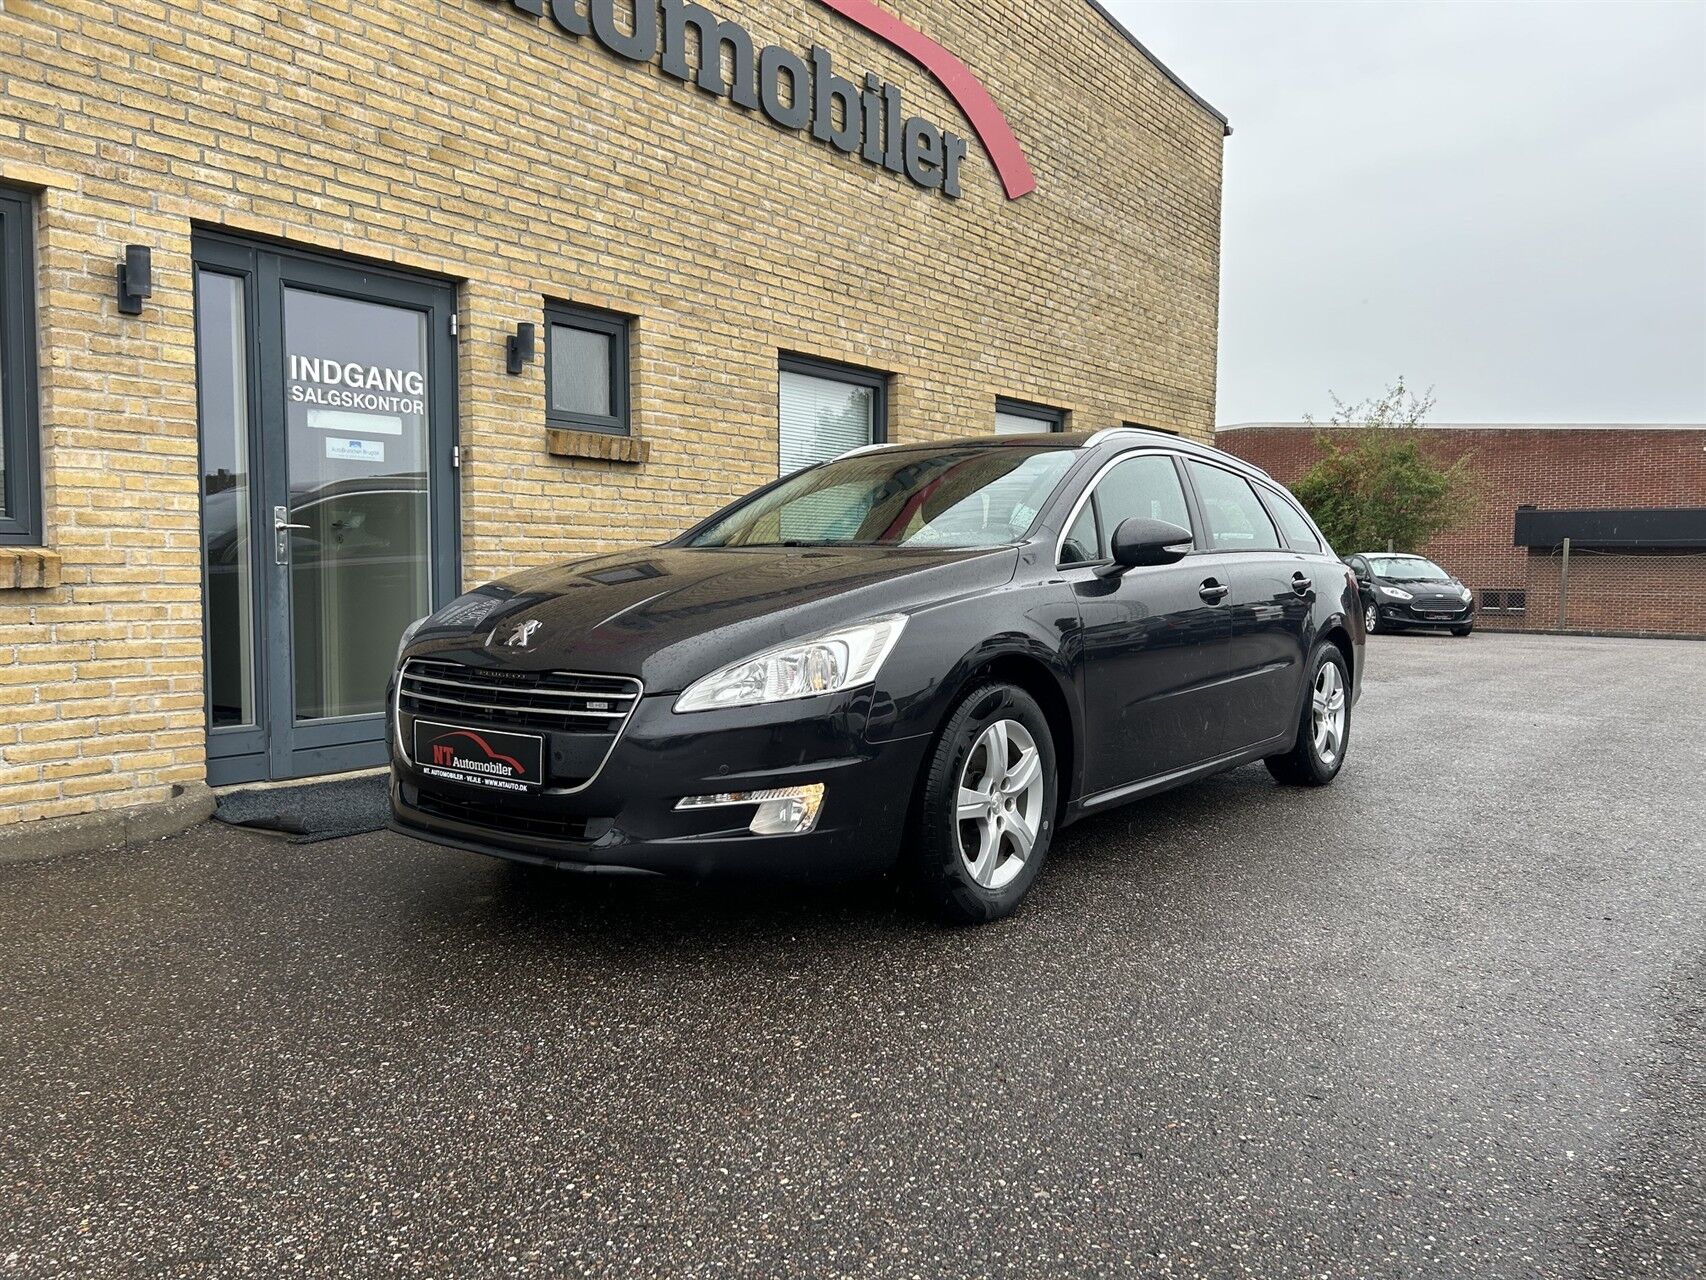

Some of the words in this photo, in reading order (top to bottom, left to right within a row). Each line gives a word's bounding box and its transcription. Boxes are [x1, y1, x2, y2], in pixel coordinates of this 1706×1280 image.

[513, 0, 967, 199] omobiler
[290, 354, 424, 396] INDGANG
[291, 385, 424, 415] SALGSKONTOR
[433, 744, 454, 767] NT
[452, 756, 513, 776] Automobiler
[431, 768, 464, 780] AUTOMOBILER
[484, 778, 528, 792] WWW.NTAUTO.DK
